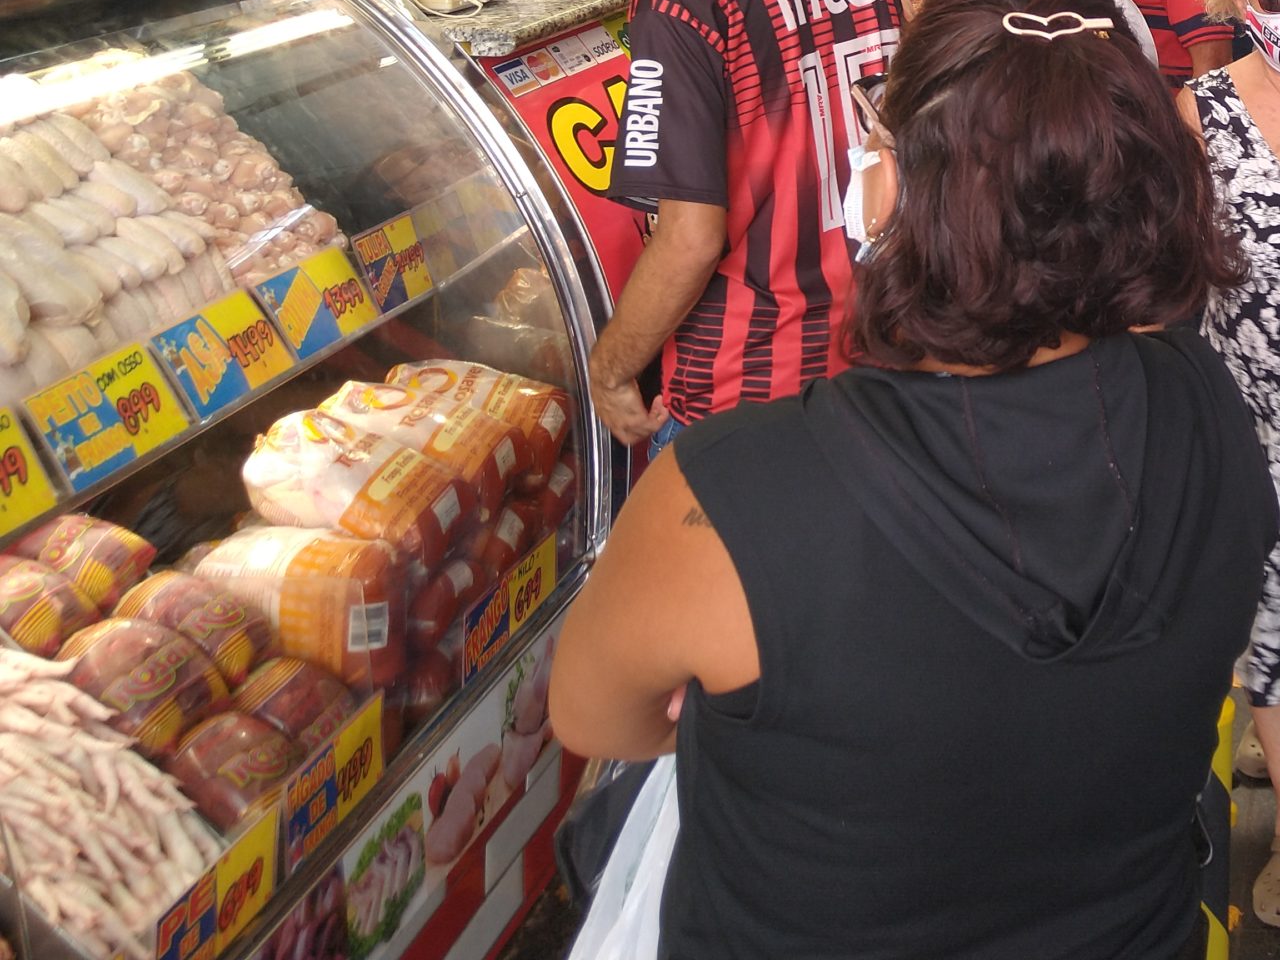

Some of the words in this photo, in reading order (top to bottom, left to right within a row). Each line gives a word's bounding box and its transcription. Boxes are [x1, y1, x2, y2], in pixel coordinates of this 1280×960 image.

[592, 40, 620, 58] sodexo
[505, 70, 531, 86] VISA
[624, 58, 664, 168] URBANO
[356, 230, 391, 265] TULIPA
[97, 368, 119, 392] COM
[118, 351, 143, 376] OSSO
[179, 318, 233, 405] ASA
[518, 554, 534, 579] KILO
[465, 578, 509, 676] FRANGO
[310, 787, 327, 822] DE
